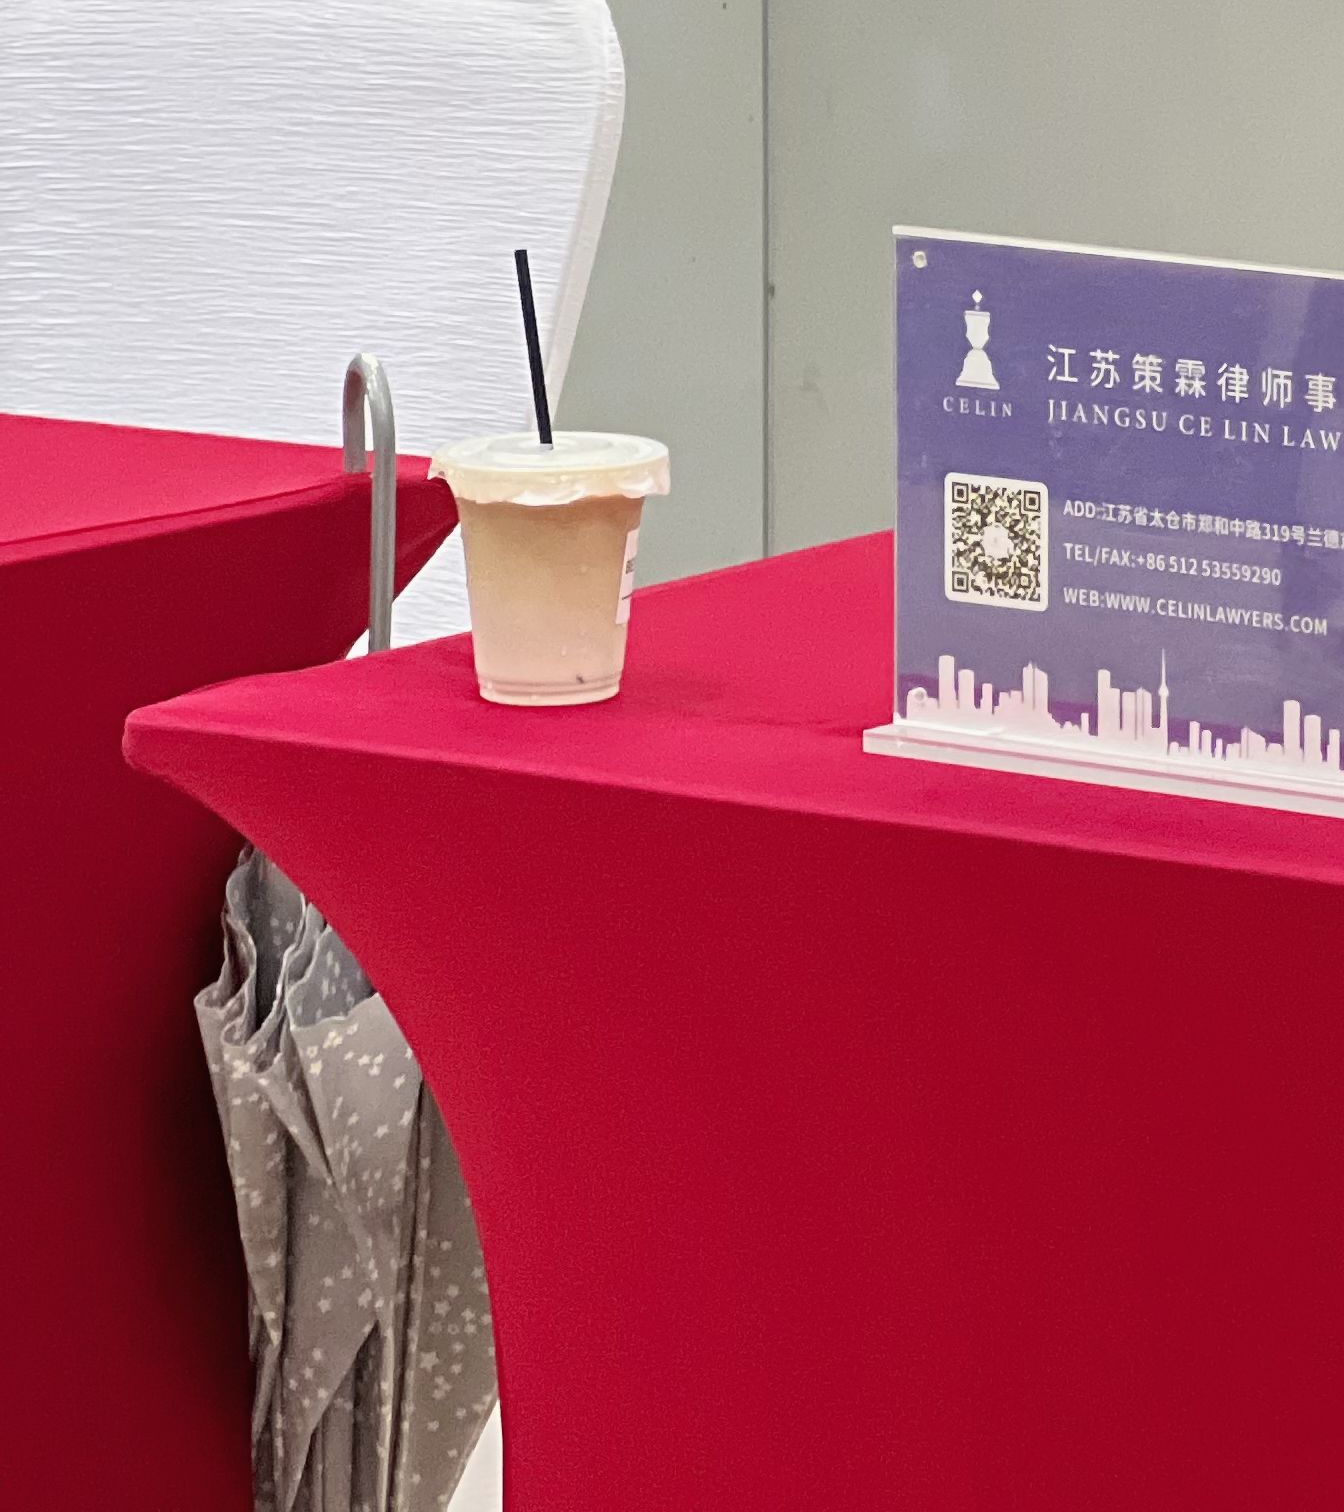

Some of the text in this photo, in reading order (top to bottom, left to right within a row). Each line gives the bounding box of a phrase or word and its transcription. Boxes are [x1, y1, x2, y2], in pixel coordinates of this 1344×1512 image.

[942, 395, 1013, 418] CELIN
[1047, 399, 1168, 432] JIANGSU
[1178, 414, 1213, 438] CE
[1223, 419, 1271, 444] LIN
[1281, 425, 1343, 452] LAW
[1201, 559, 1282, 587] 53559290
[1062, 587, 1328, 637] WEB:WWW.CELINLAWYERS.COM
